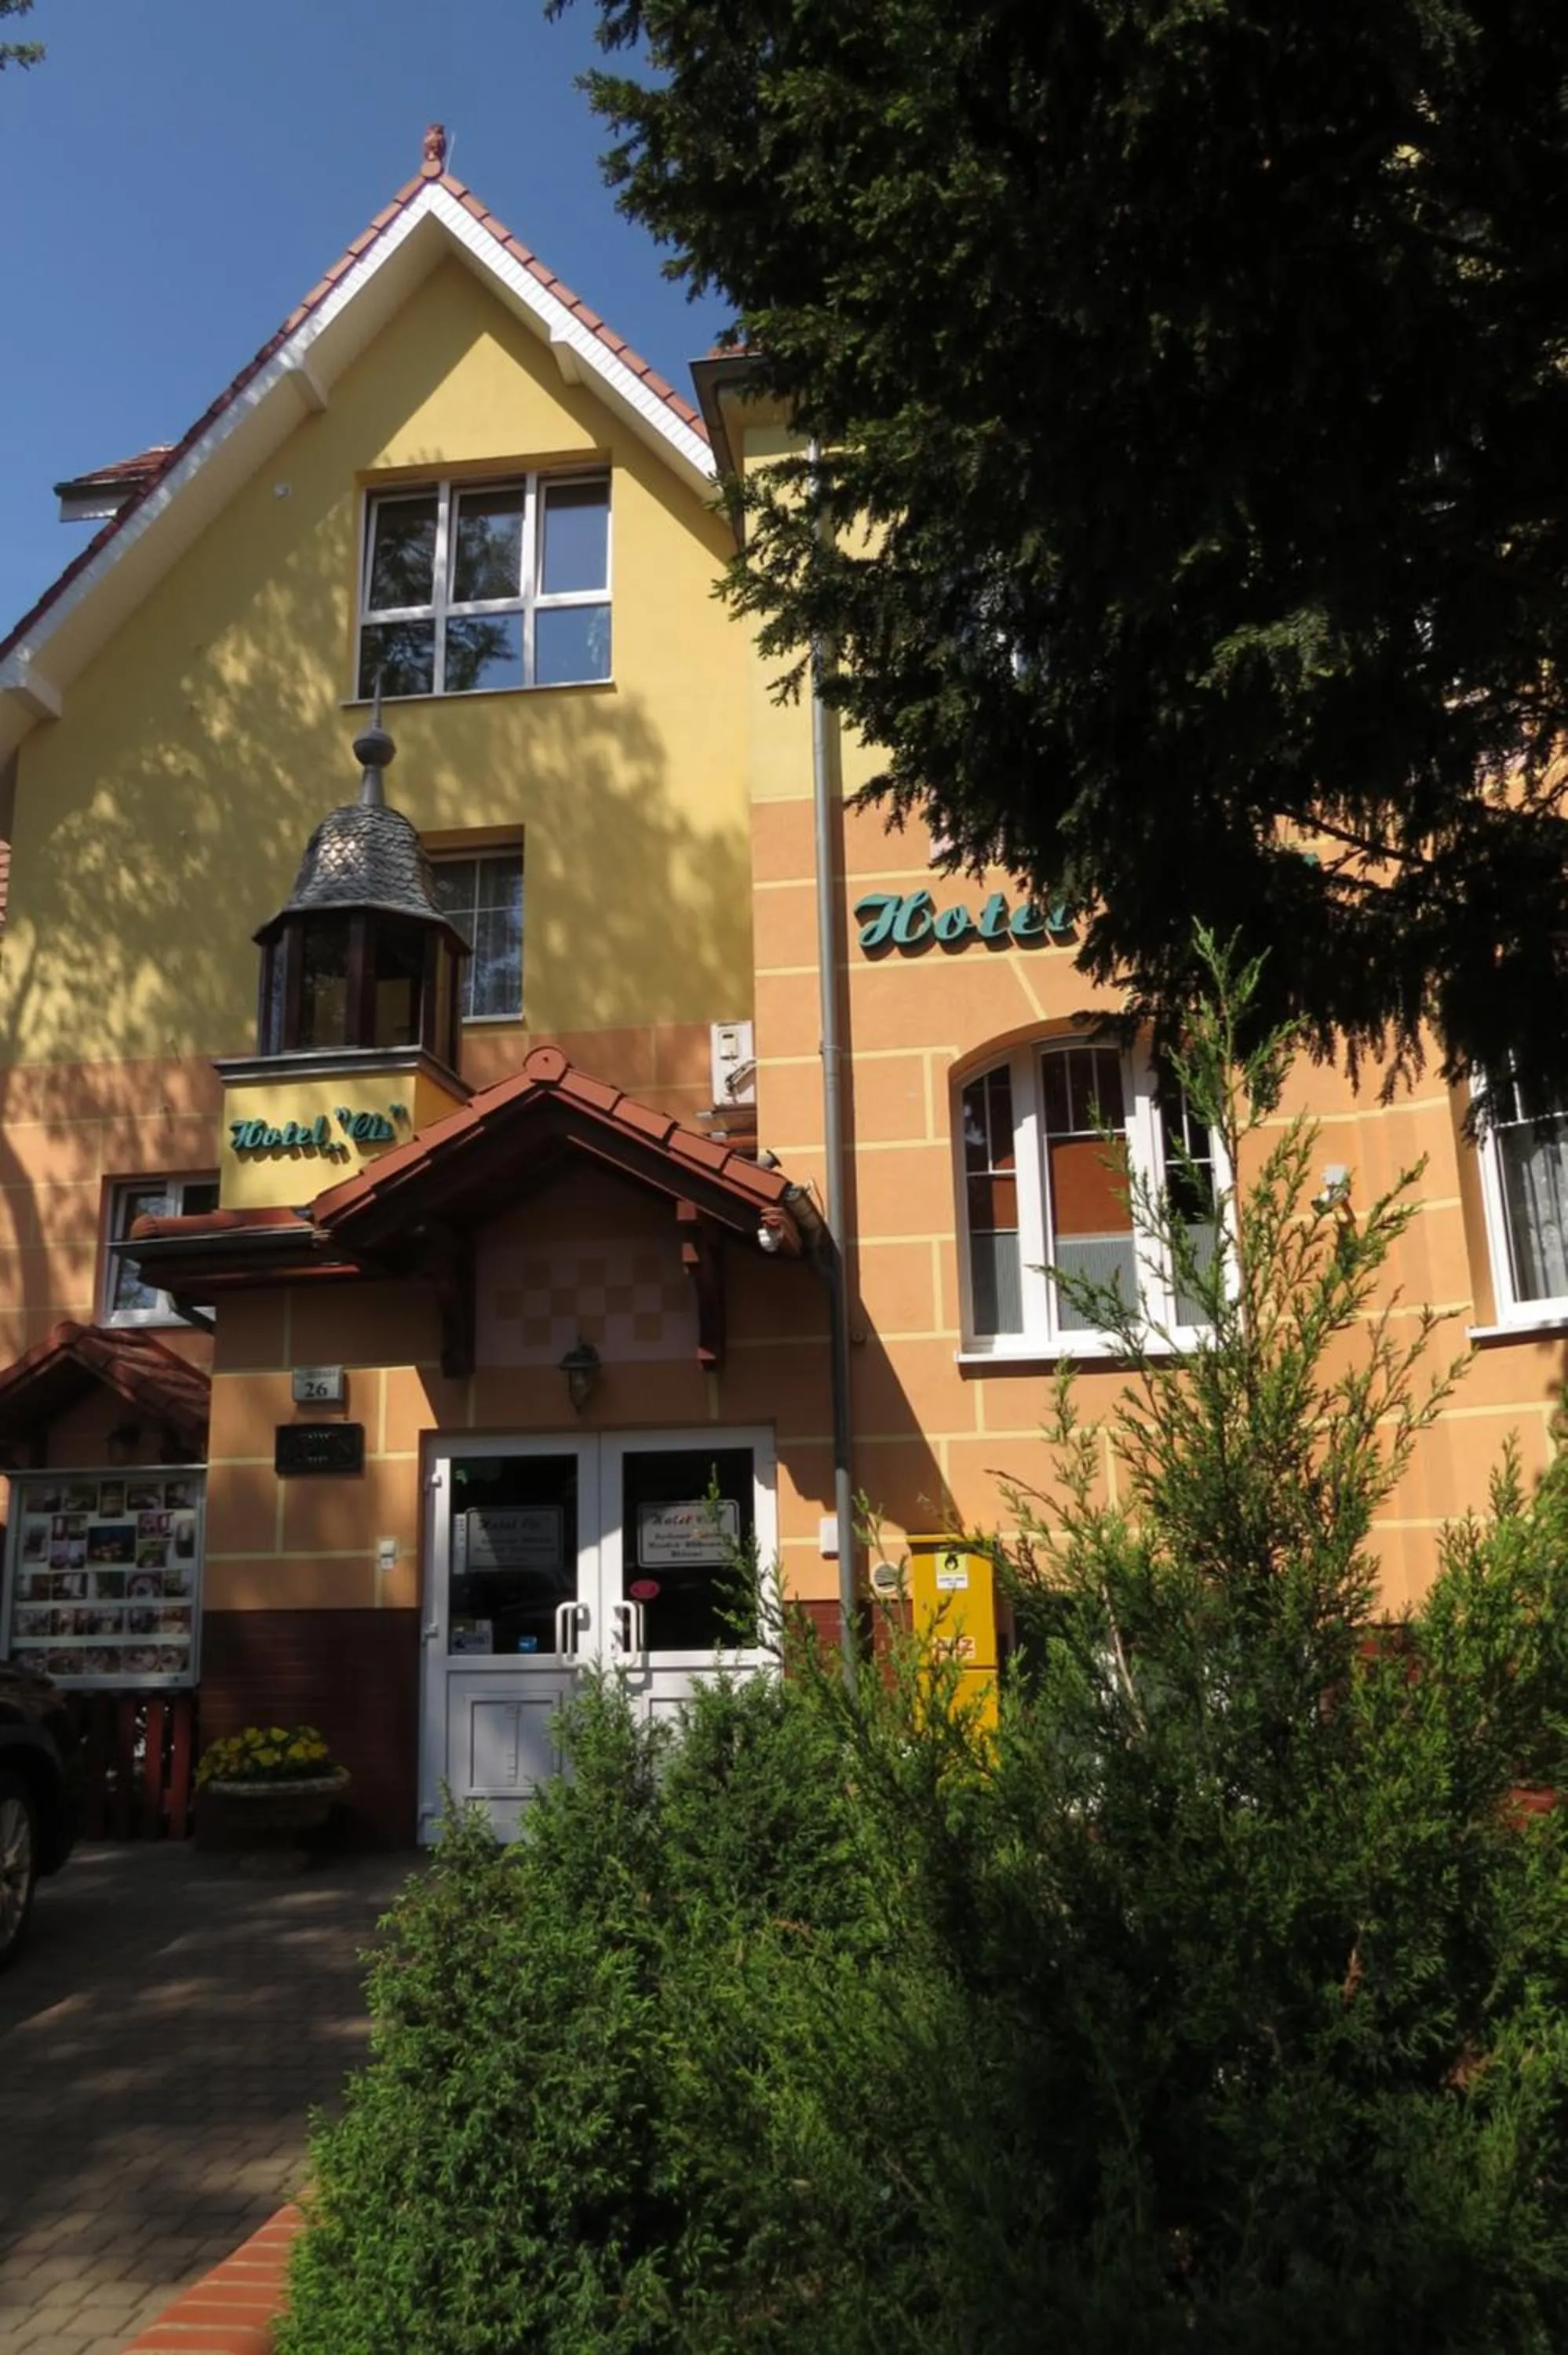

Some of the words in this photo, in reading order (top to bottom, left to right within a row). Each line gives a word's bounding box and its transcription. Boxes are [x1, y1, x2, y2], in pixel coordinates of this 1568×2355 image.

[854, 890, 1075, 947] Hotel
[230, 1115, 328, 1148] Hotel
[304, 1381, 328, 1398] 26
